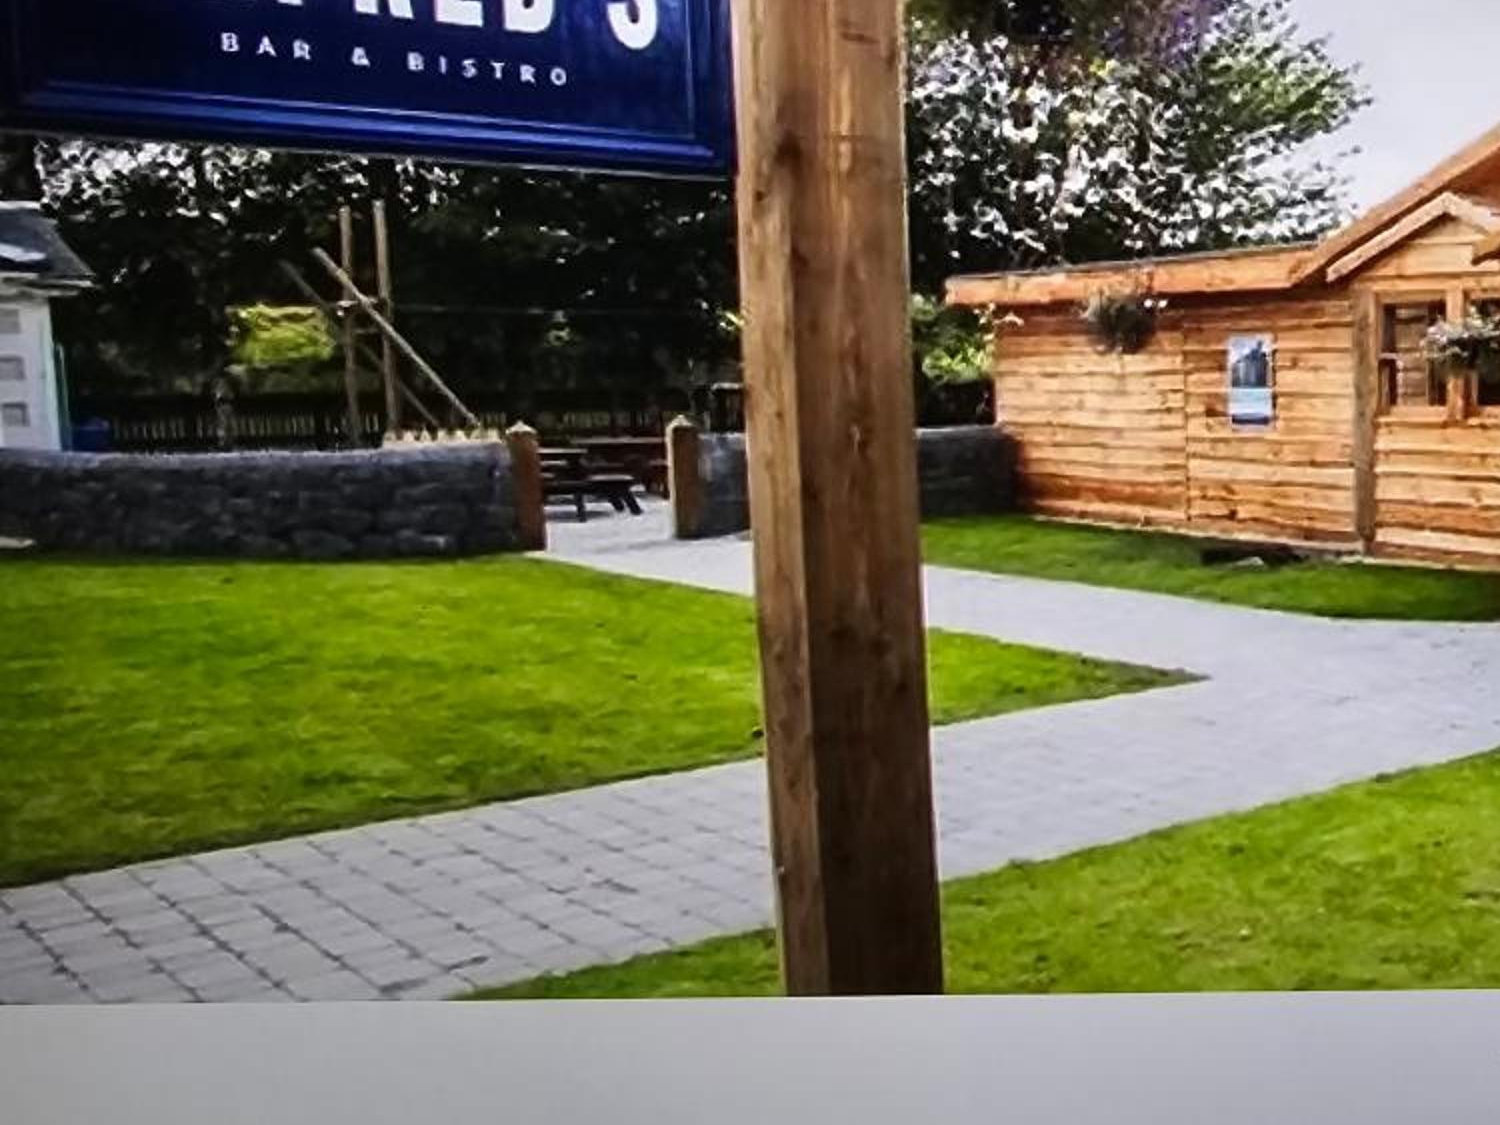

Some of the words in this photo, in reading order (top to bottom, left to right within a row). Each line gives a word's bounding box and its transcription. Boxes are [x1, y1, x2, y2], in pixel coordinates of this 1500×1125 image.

[221, 32, 311, 61] BAR
[351, 46, 370, 67] &
[407, 51, 568, 87] BISTRO
